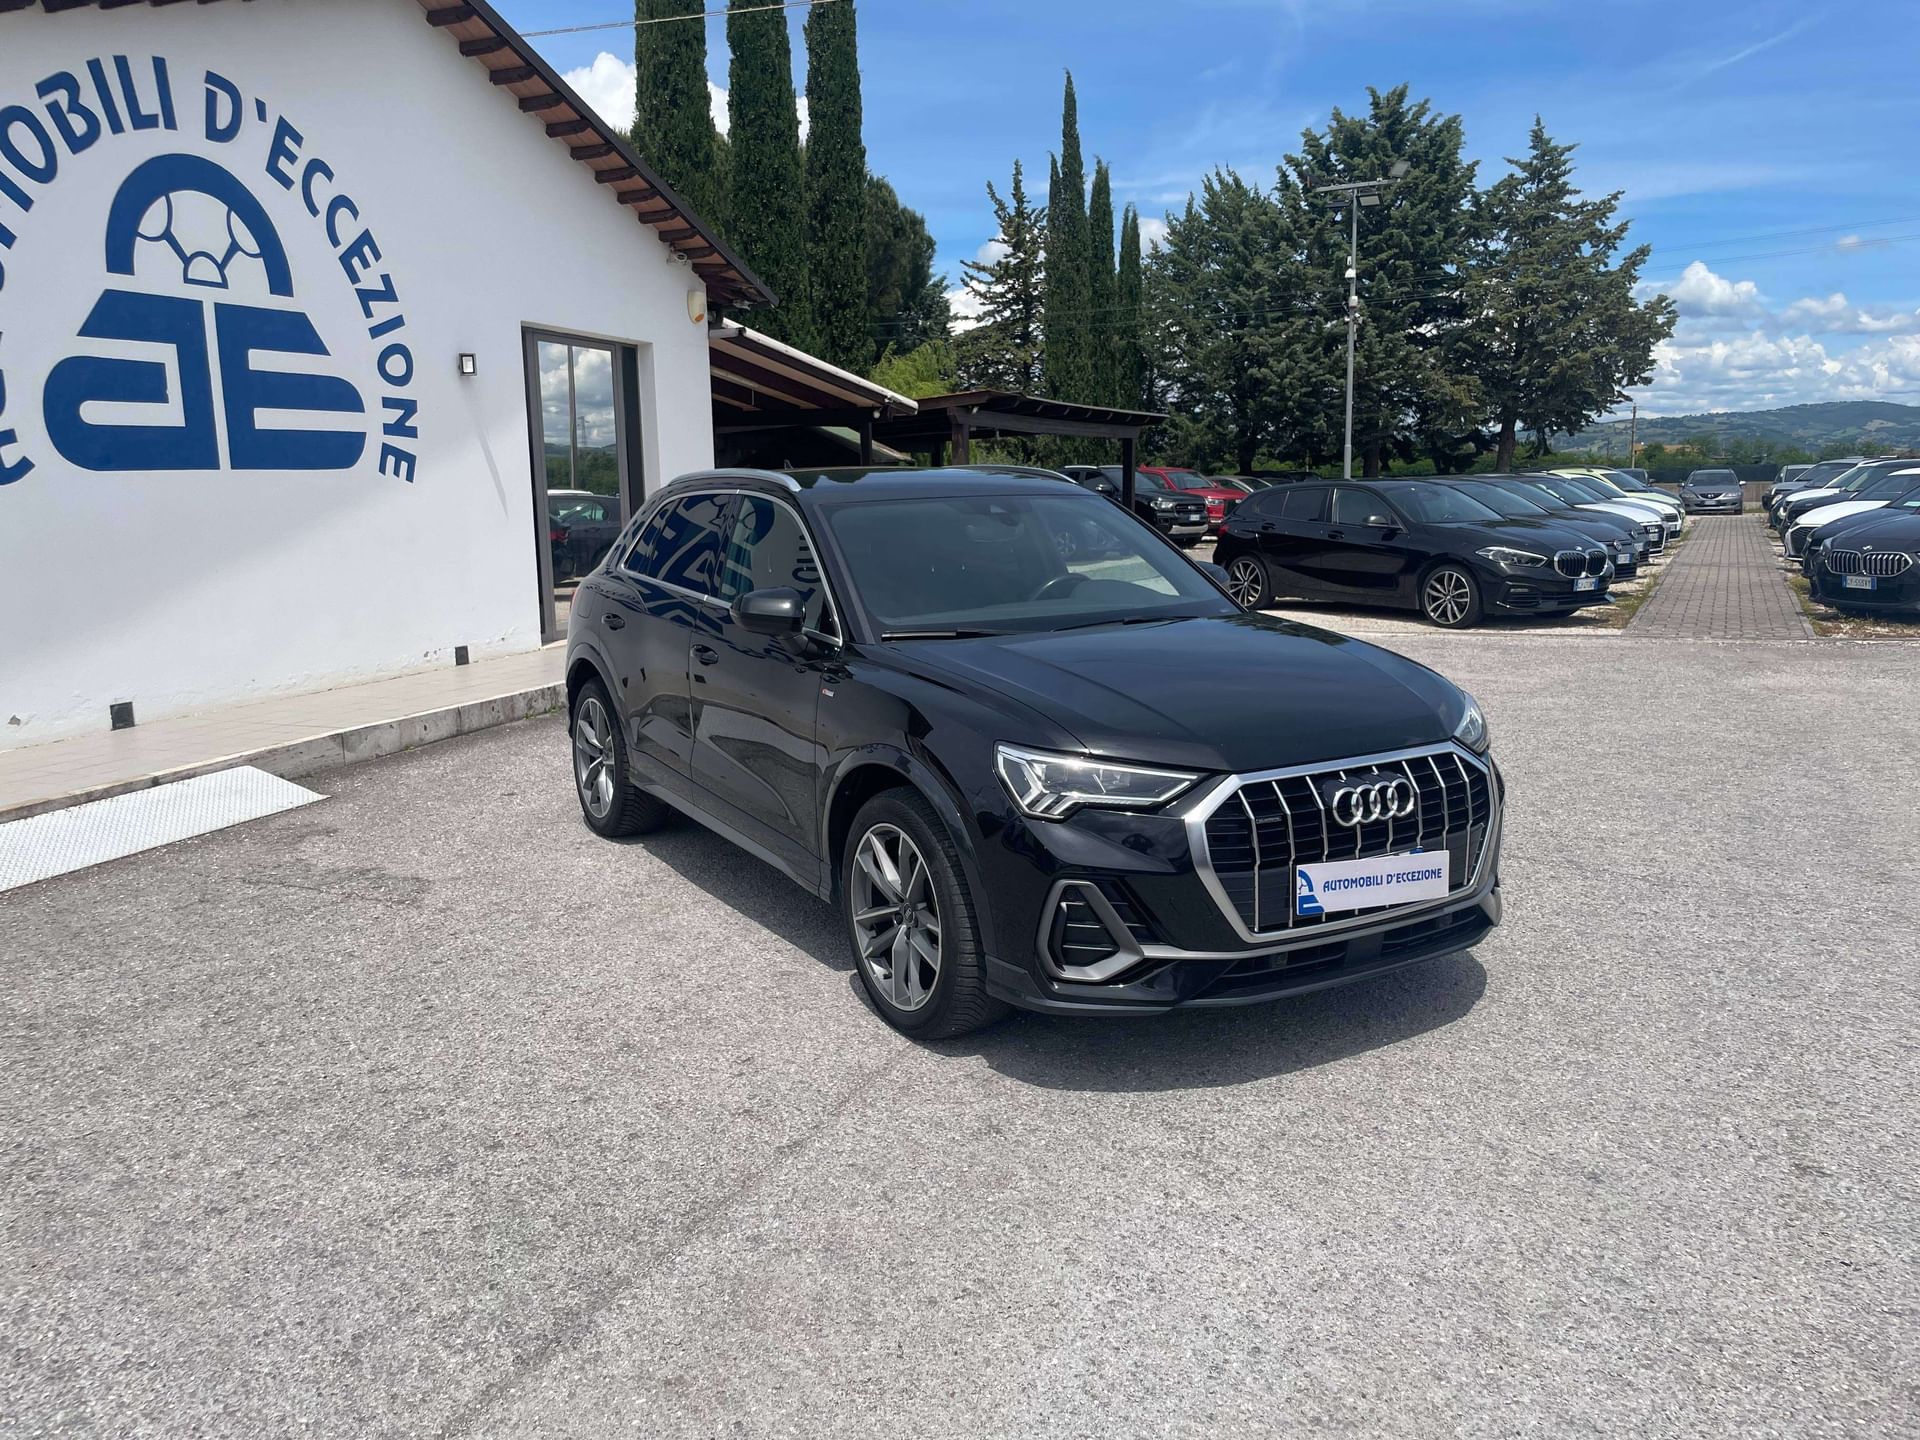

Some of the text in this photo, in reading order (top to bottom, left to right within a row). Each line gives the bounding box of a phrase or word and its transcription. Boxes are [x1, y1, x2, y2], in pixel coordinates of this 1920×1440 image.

[205, 70, 418, 484] D'ECCEZIONE
[1323, 868, 1442, 892] AUTOMOBILI D'ECCEZIONE
